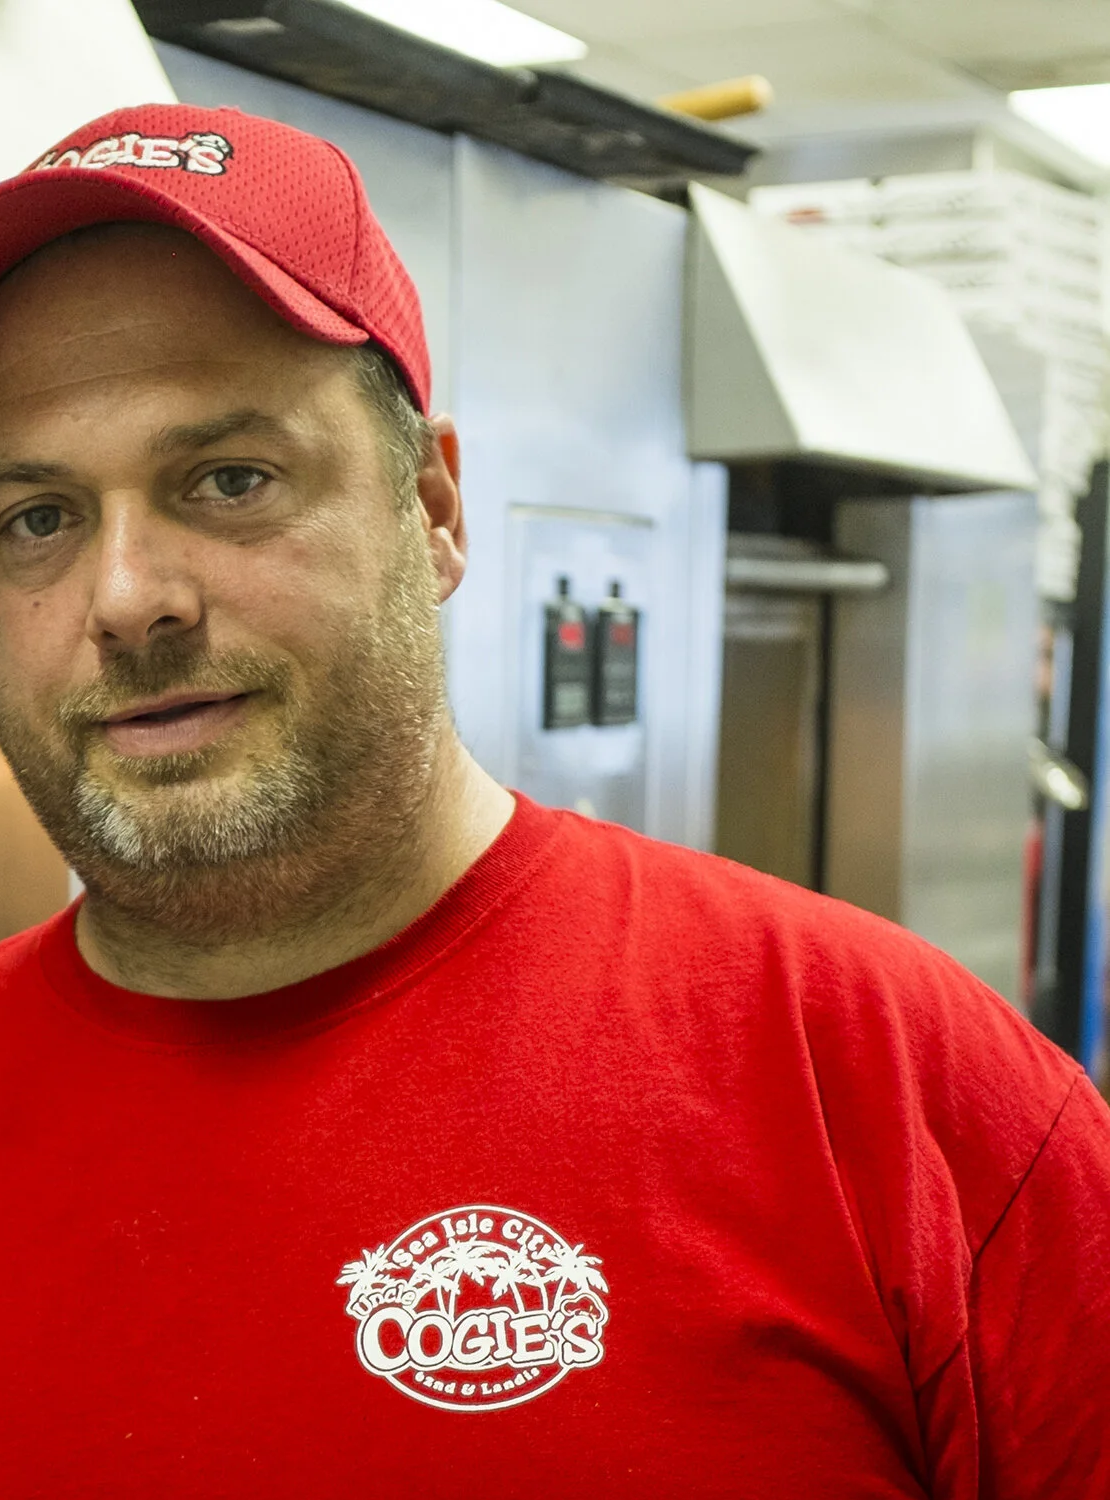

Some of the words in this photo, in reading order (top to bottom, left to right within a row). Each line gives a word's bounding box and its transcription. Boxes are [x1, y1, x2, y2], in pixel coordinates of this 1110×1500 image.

[393, 1230, 438, 1267] Sea
[442, 1213, 494, 1237] Isle
[501, 1219, 564, 1260] City
[352, 1287, 417, 1316] Uncle
[361, 1306, 601, 1371] COGIE'S
[414, 1371, 455, 1395] 62nd
[461, 1383, 476, 1396] &
[481, 1367, 540, 1395] Landis
